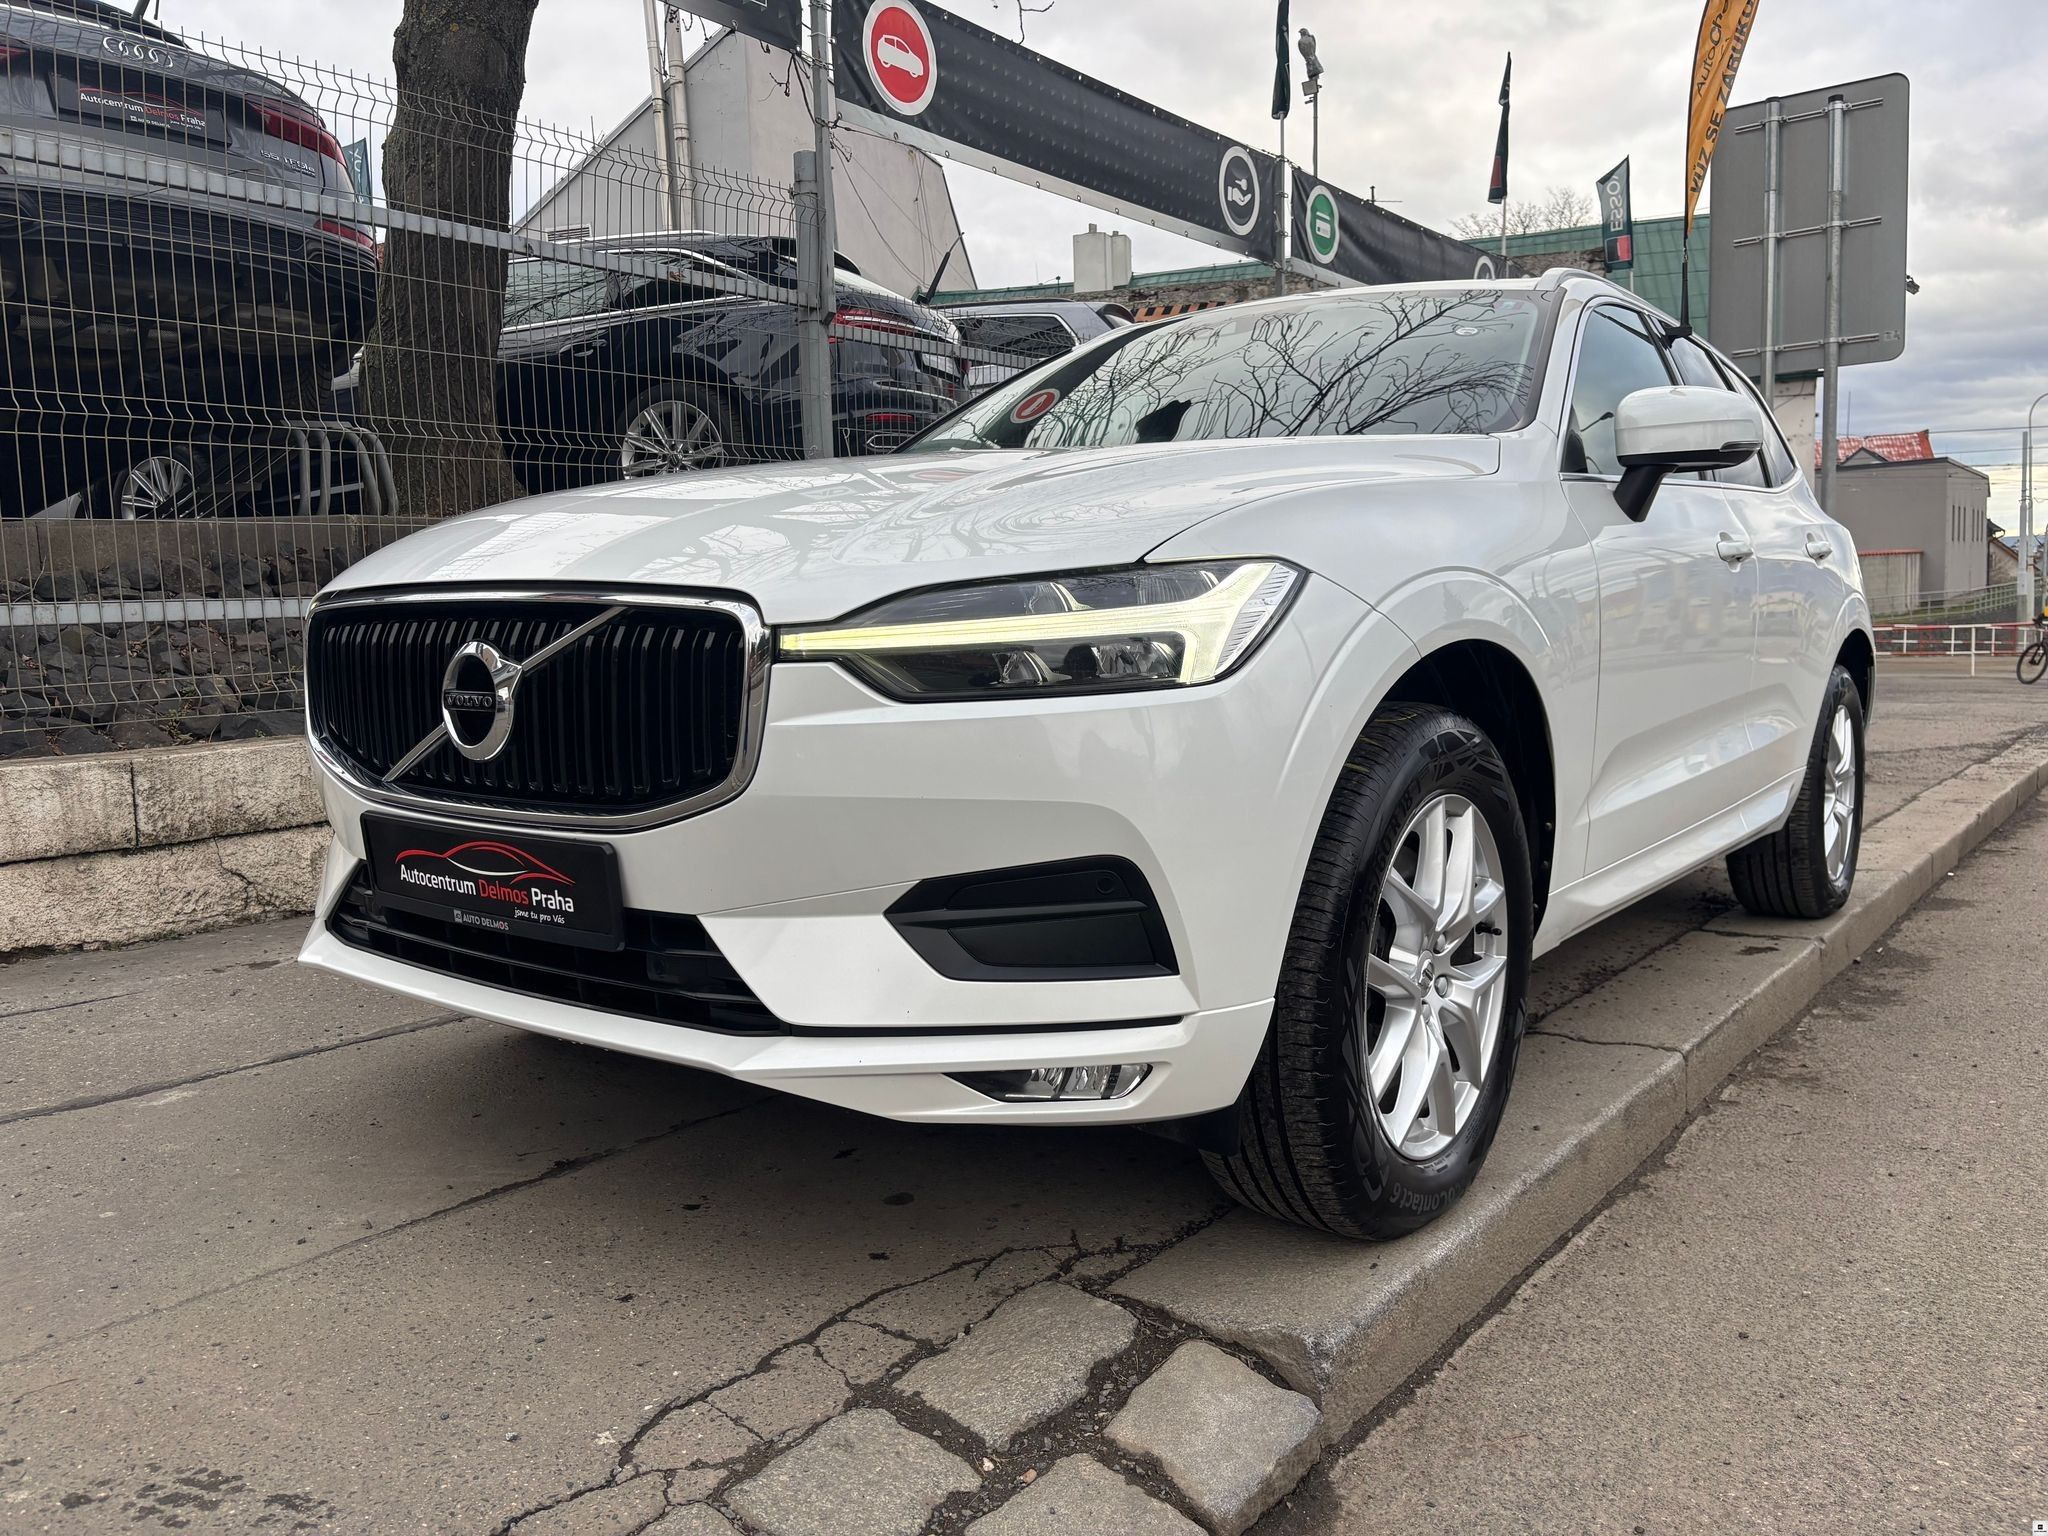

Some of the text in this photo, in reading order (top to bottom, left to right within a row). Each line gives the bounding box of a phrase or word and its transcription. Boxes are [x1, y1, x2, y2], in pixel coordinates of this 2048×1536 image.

[80, 92, 144, 113] Autocentrum
[1706, 109, 1723, 143] SE
[445, 693, 493, 709] VOLVO
[400, 863, 575, 913] Autocentrum Delmos Praha
[463, 913, 509, 931] AUTO DELMOS
[530, 911, 538, 919] tu
[540, 914, 551, 923] pro
